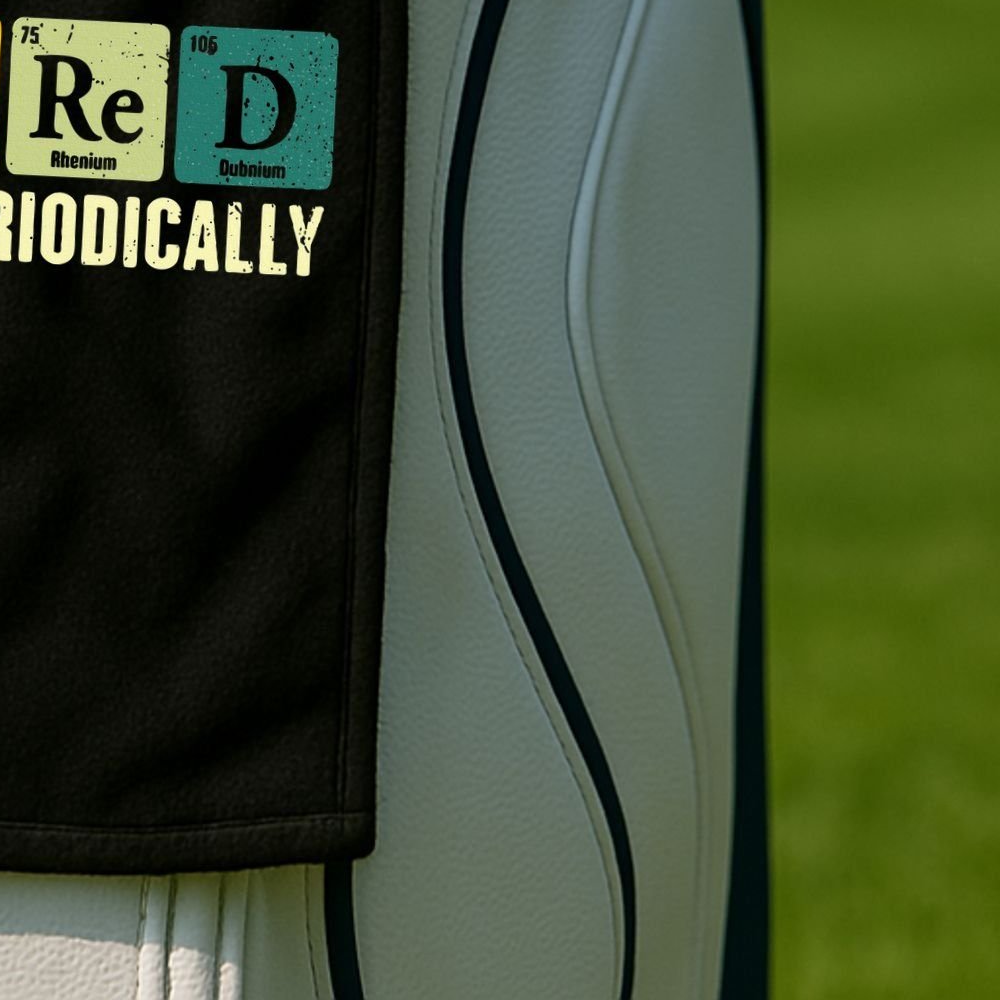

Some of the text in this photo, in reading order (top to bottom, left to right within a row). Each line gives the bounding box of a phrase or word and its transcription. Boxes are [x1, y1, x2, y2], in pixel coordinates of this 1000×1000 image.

[21, 26, 40, 44] 75
[29, 54, 144, 144] Re
[215, 64, 297, 150] D
[50, 150, 117, 171] Rhenium
[219, 158, 286, 179] Dubnium
